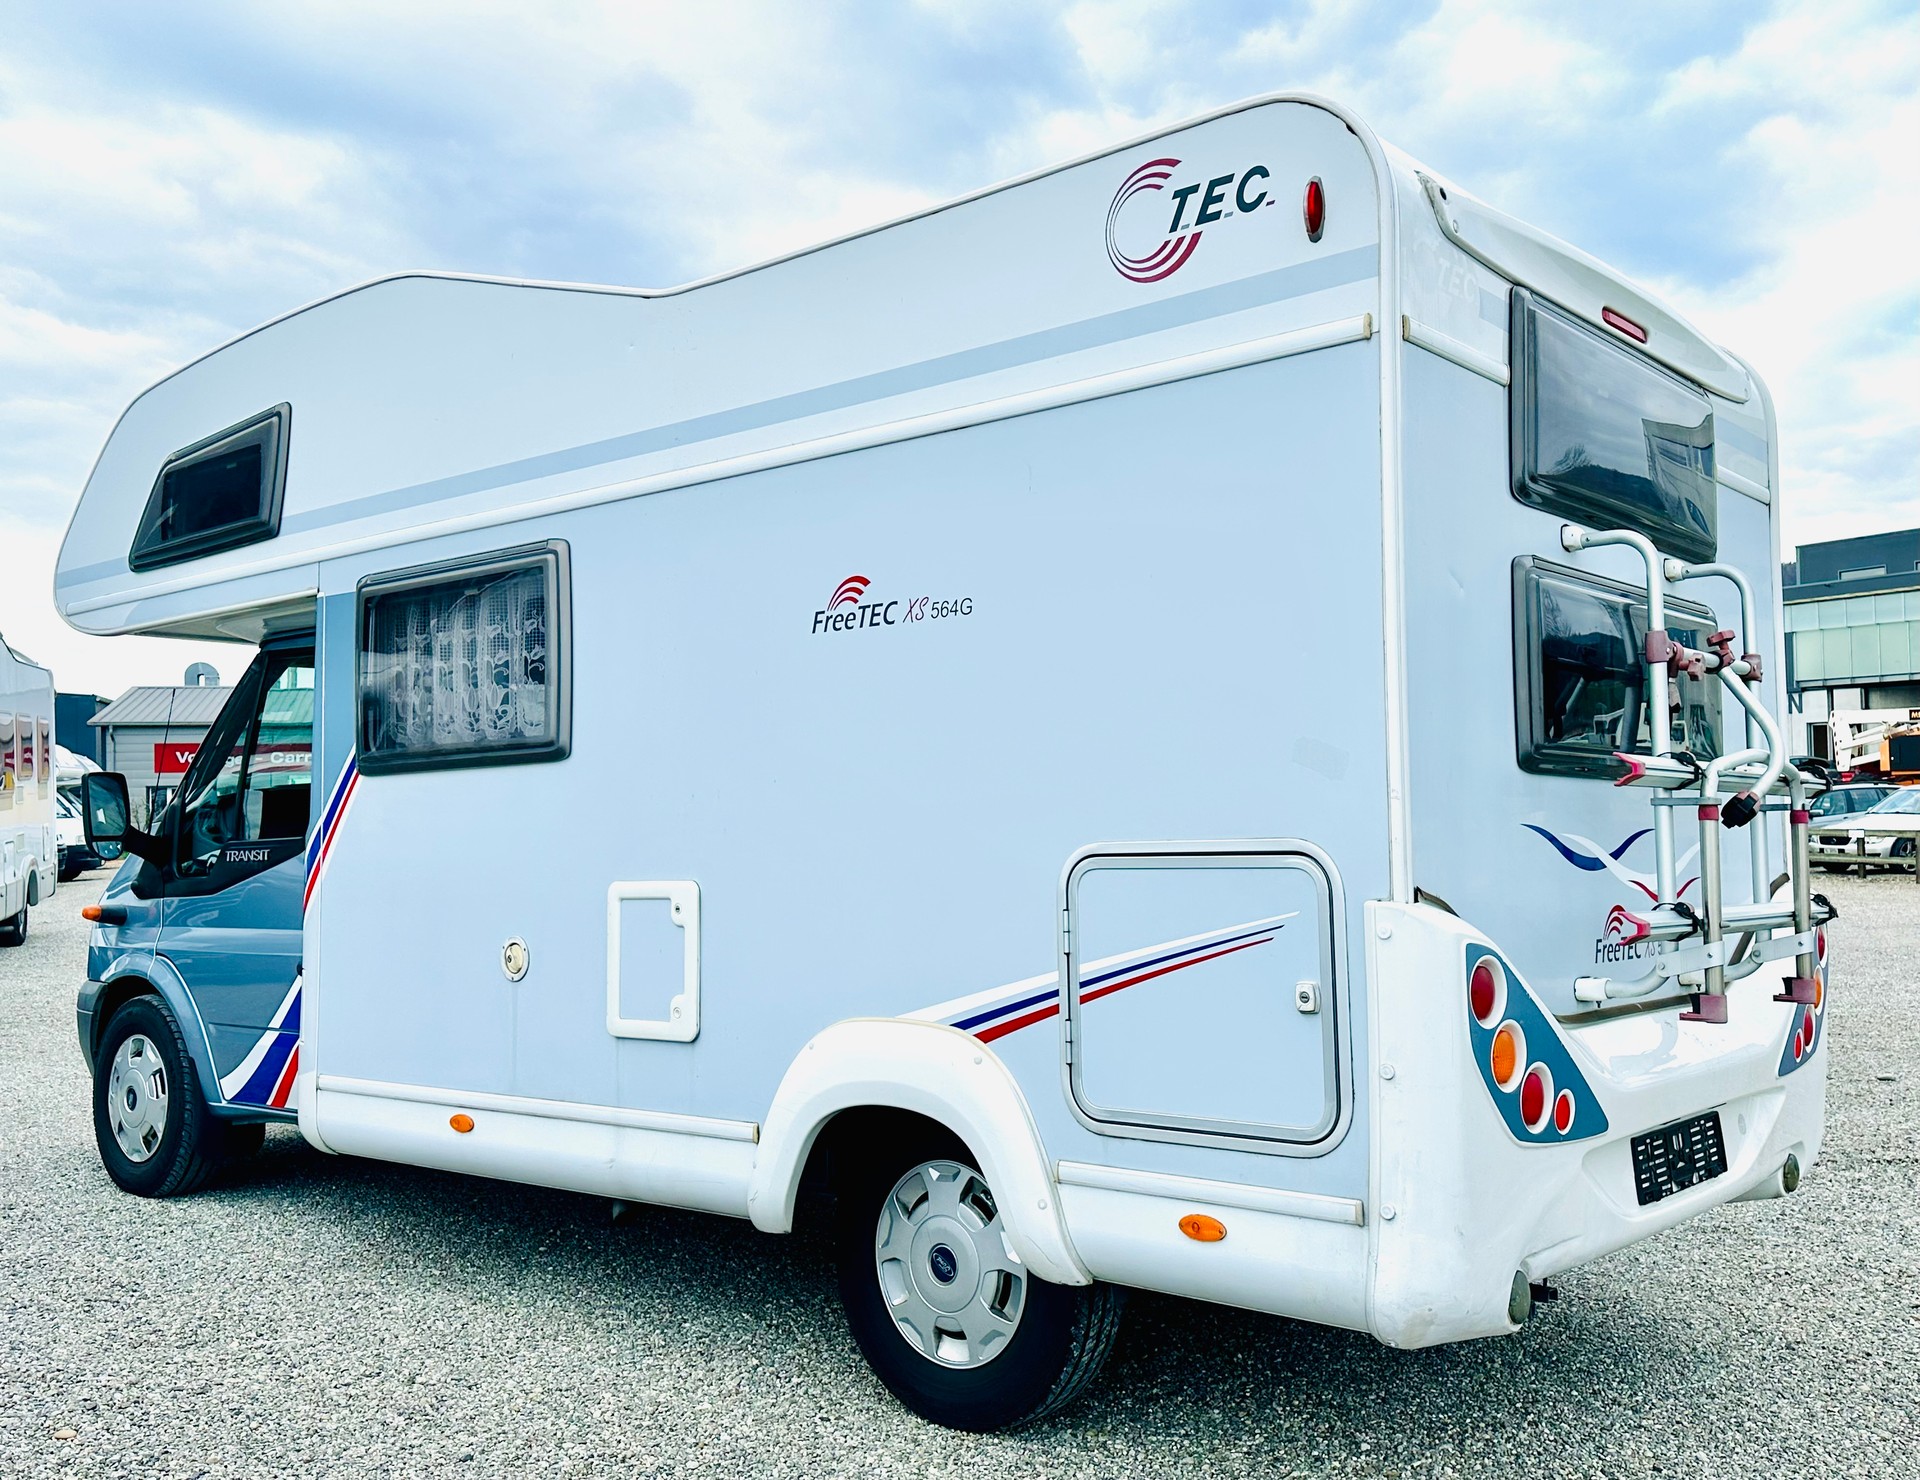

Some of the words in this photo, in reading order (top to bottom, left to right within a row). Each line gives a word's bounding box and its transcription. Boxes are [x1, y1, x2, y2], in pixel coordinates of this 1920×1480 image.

[811, 600, 899, 634] FreeTEC
[902, 596, 930, 624] XS
[930, 597, 973, 619] 564G
[225, 849, 270, 862] TRANSIT
